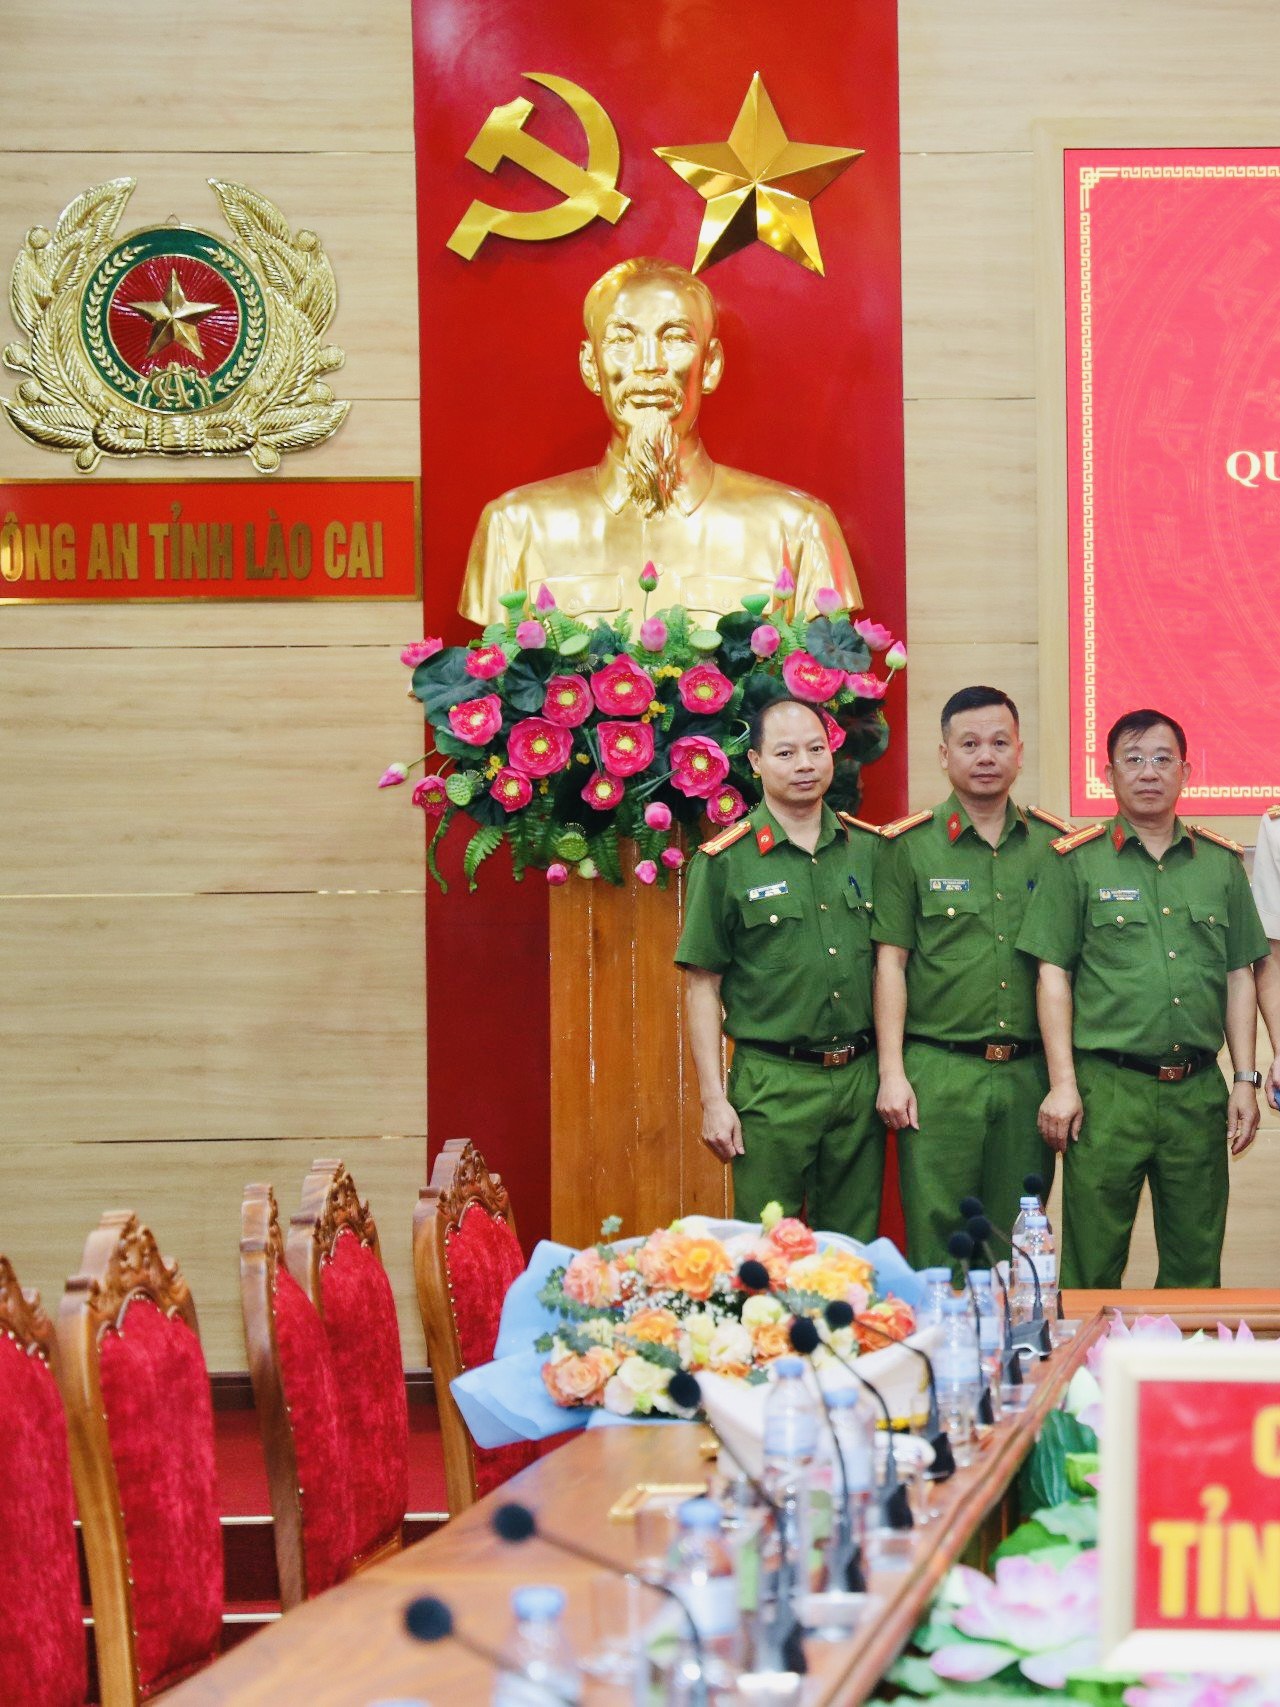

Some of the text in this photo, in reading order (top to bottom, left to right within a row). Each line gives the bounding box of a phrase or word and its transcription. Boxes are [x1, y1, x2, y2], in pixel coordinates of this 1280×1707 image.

[0, 501, 384, 582] ÔNG AN TỈNH LÀO CAI
